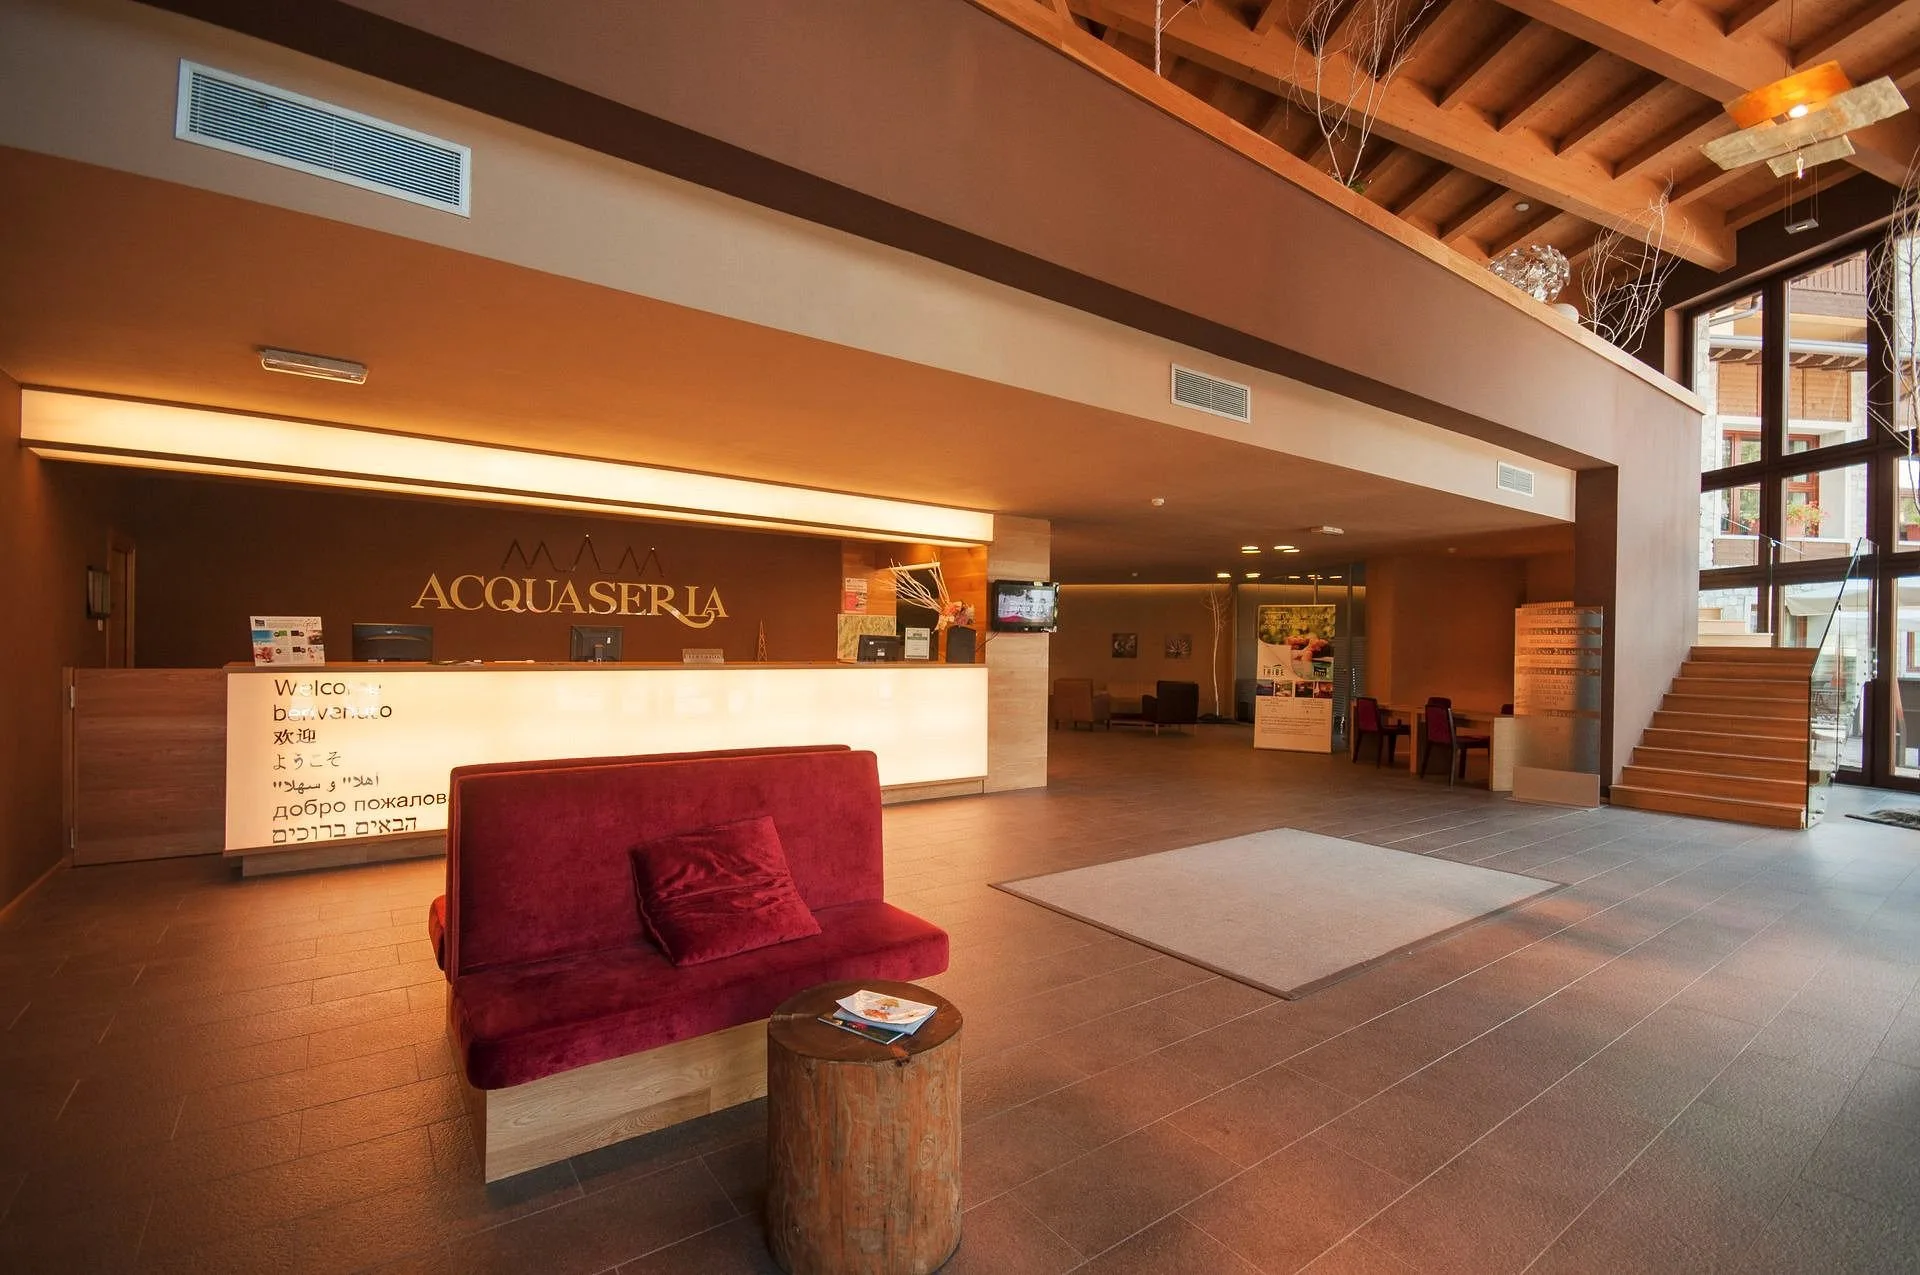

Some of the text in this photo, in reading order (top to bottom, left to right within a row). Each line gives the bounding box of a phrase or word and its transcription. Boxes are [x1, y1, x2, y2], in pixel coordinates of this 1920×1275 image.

[411, 573, 729, 628] ACQUASERIA
[274, 679, 381, 696] Welco
[273, 728, 317, 745] 欢迎
[273, 751, 341, 770] ようこそ
[328, 780, 336, 792] و
[272, 793, 448, 821] добро пожалов
[272, 816, 417, 844] הבאים ברוכים
